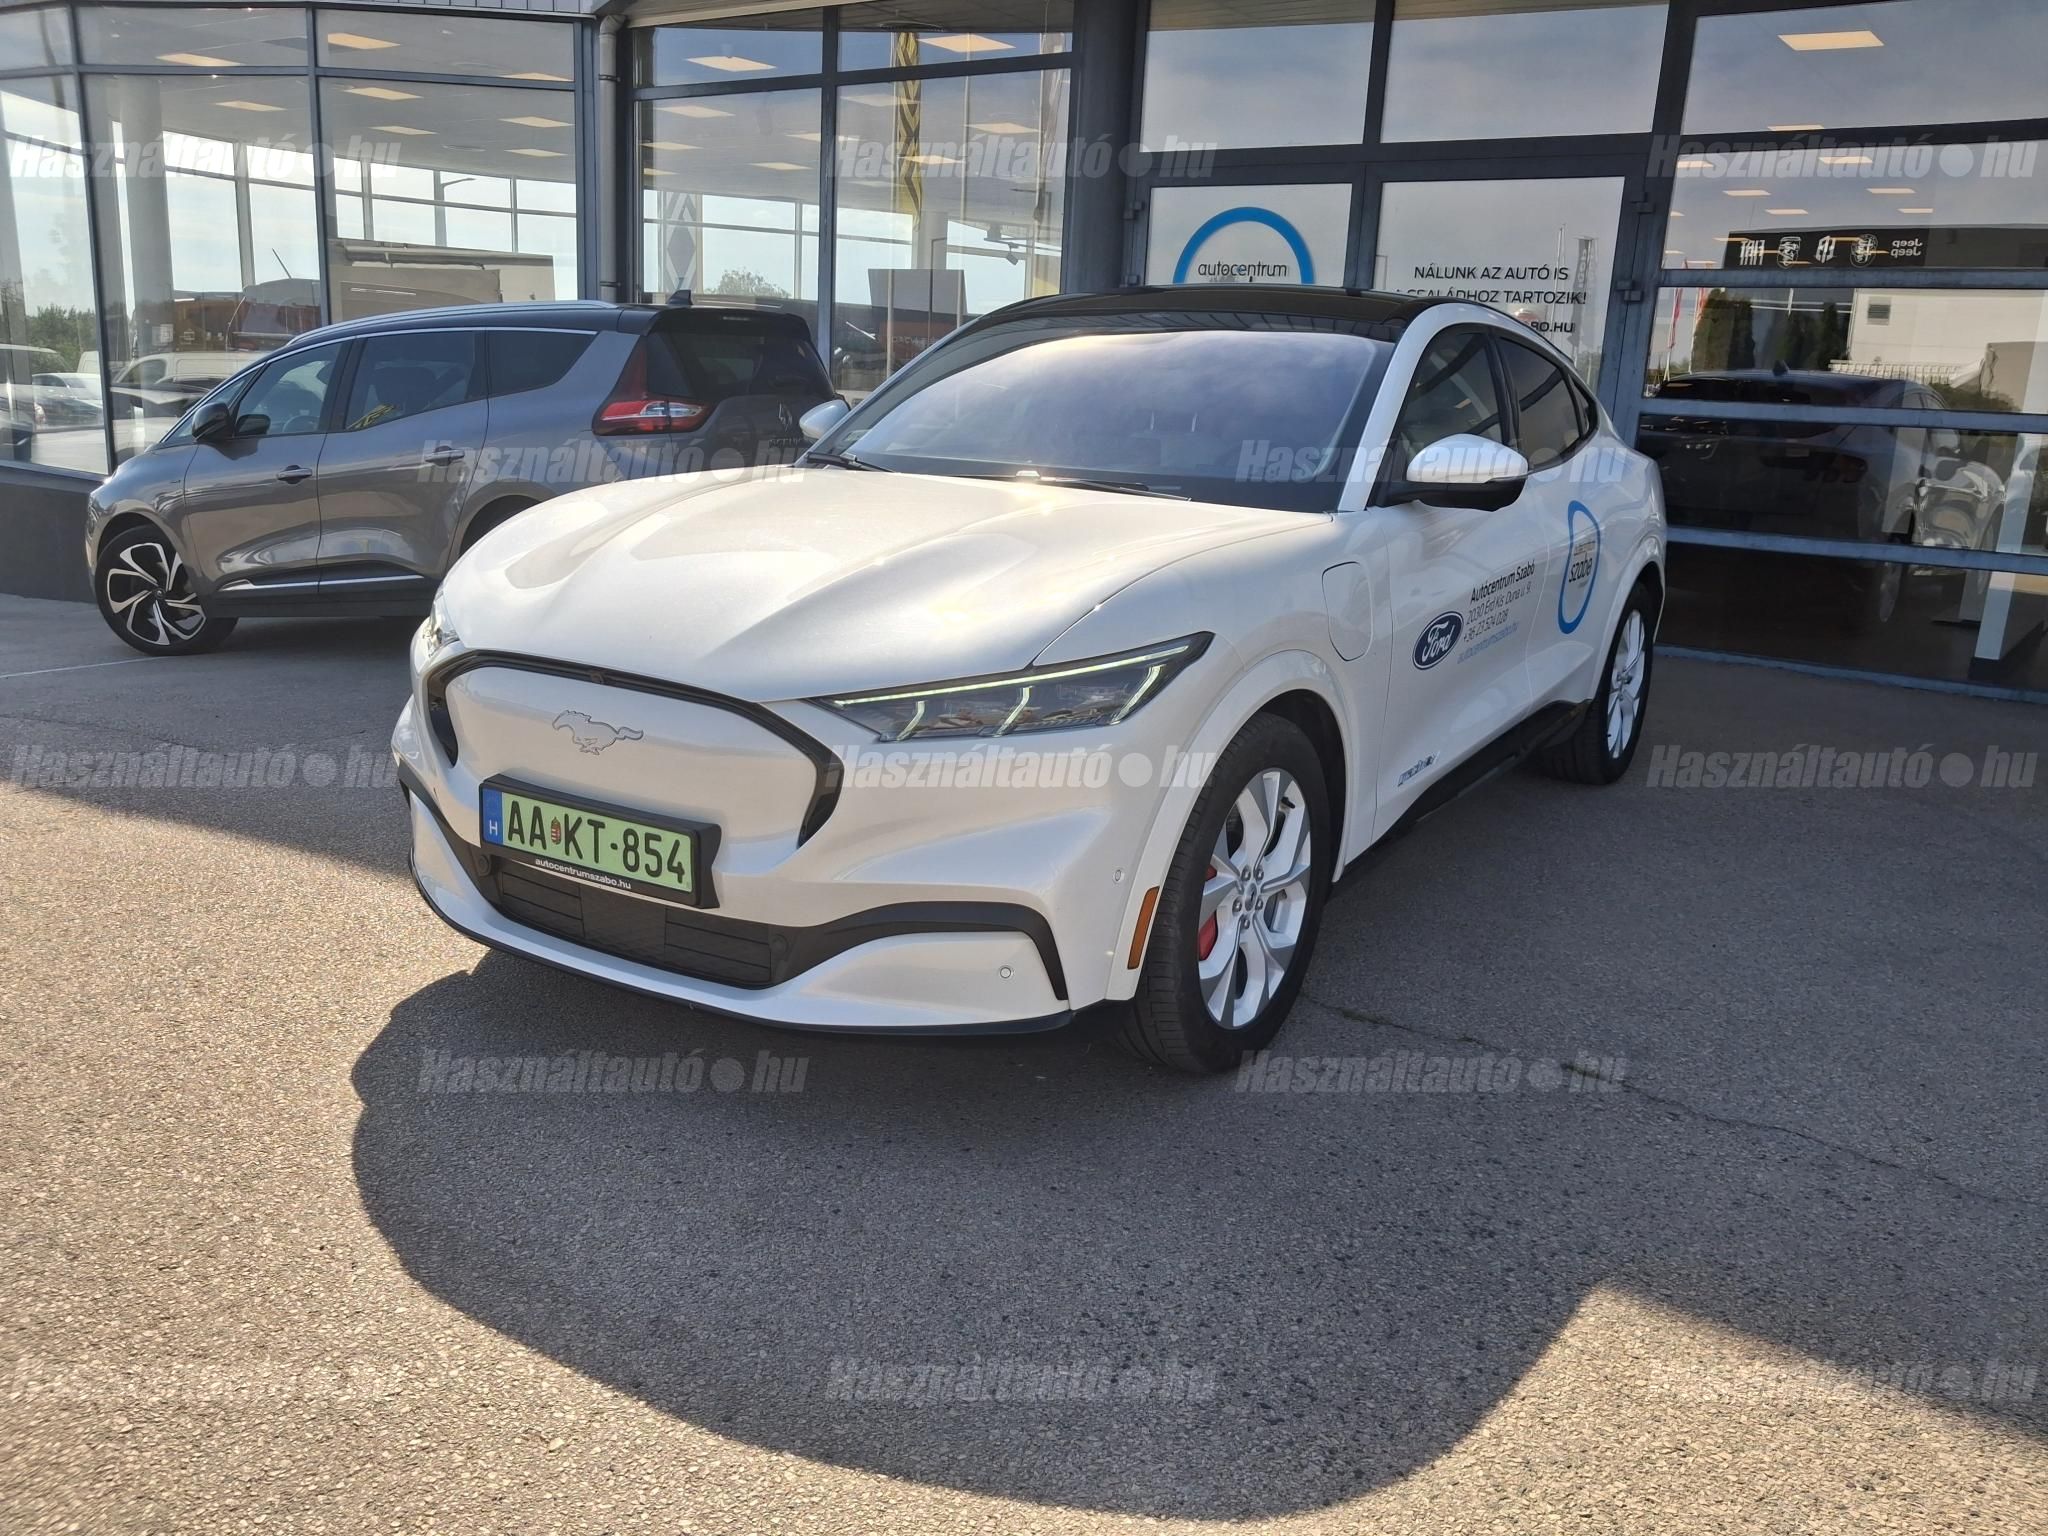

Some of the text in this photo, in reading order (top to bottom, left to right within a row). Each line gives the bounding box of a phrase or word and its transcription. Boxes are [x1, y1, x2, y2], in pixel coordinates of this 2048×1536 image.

[1198, 260, 1287, 277] autocentrum
[1414, 263, 1569, 281] NÁLUNK AZ AUTÓ IS
[1504, 290, 1587, 305] TARTOZIK!
[1470, 570, 1515, 603] Autocentrum
[1420, 619, 1457, 664] Ford
[489, 819, 498, 836] H
[535, 857, 632, 890] autocentrumszabo.hu
